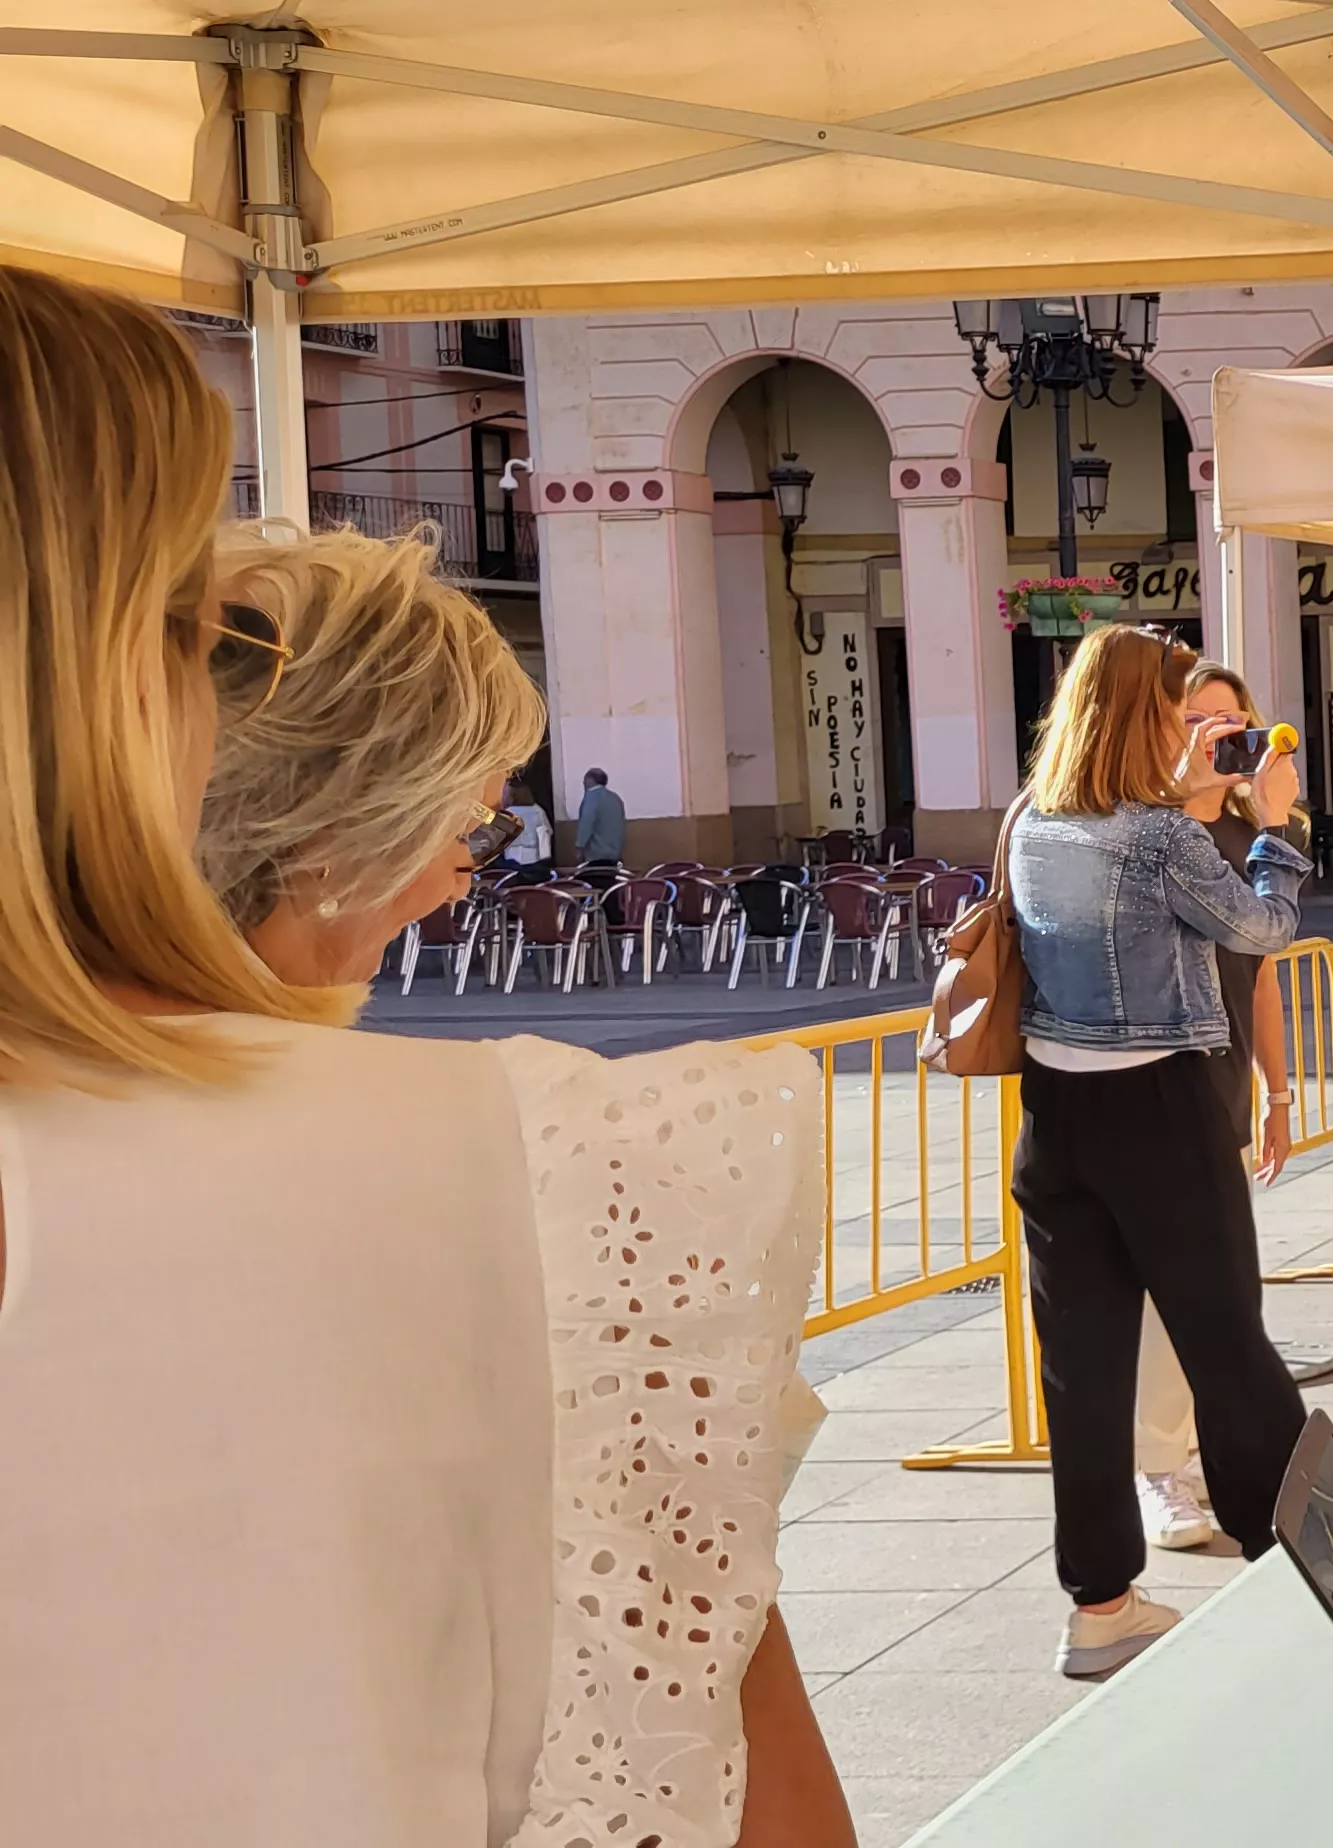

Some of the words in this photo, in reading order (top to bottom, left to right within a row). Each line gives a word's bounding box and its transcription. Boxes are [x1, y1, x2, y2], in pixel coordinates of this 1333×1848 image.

[806, 670, 821, 727] SIN
[843, 634, 858, 672] NO
[851, 679, 865, 738] HAY
